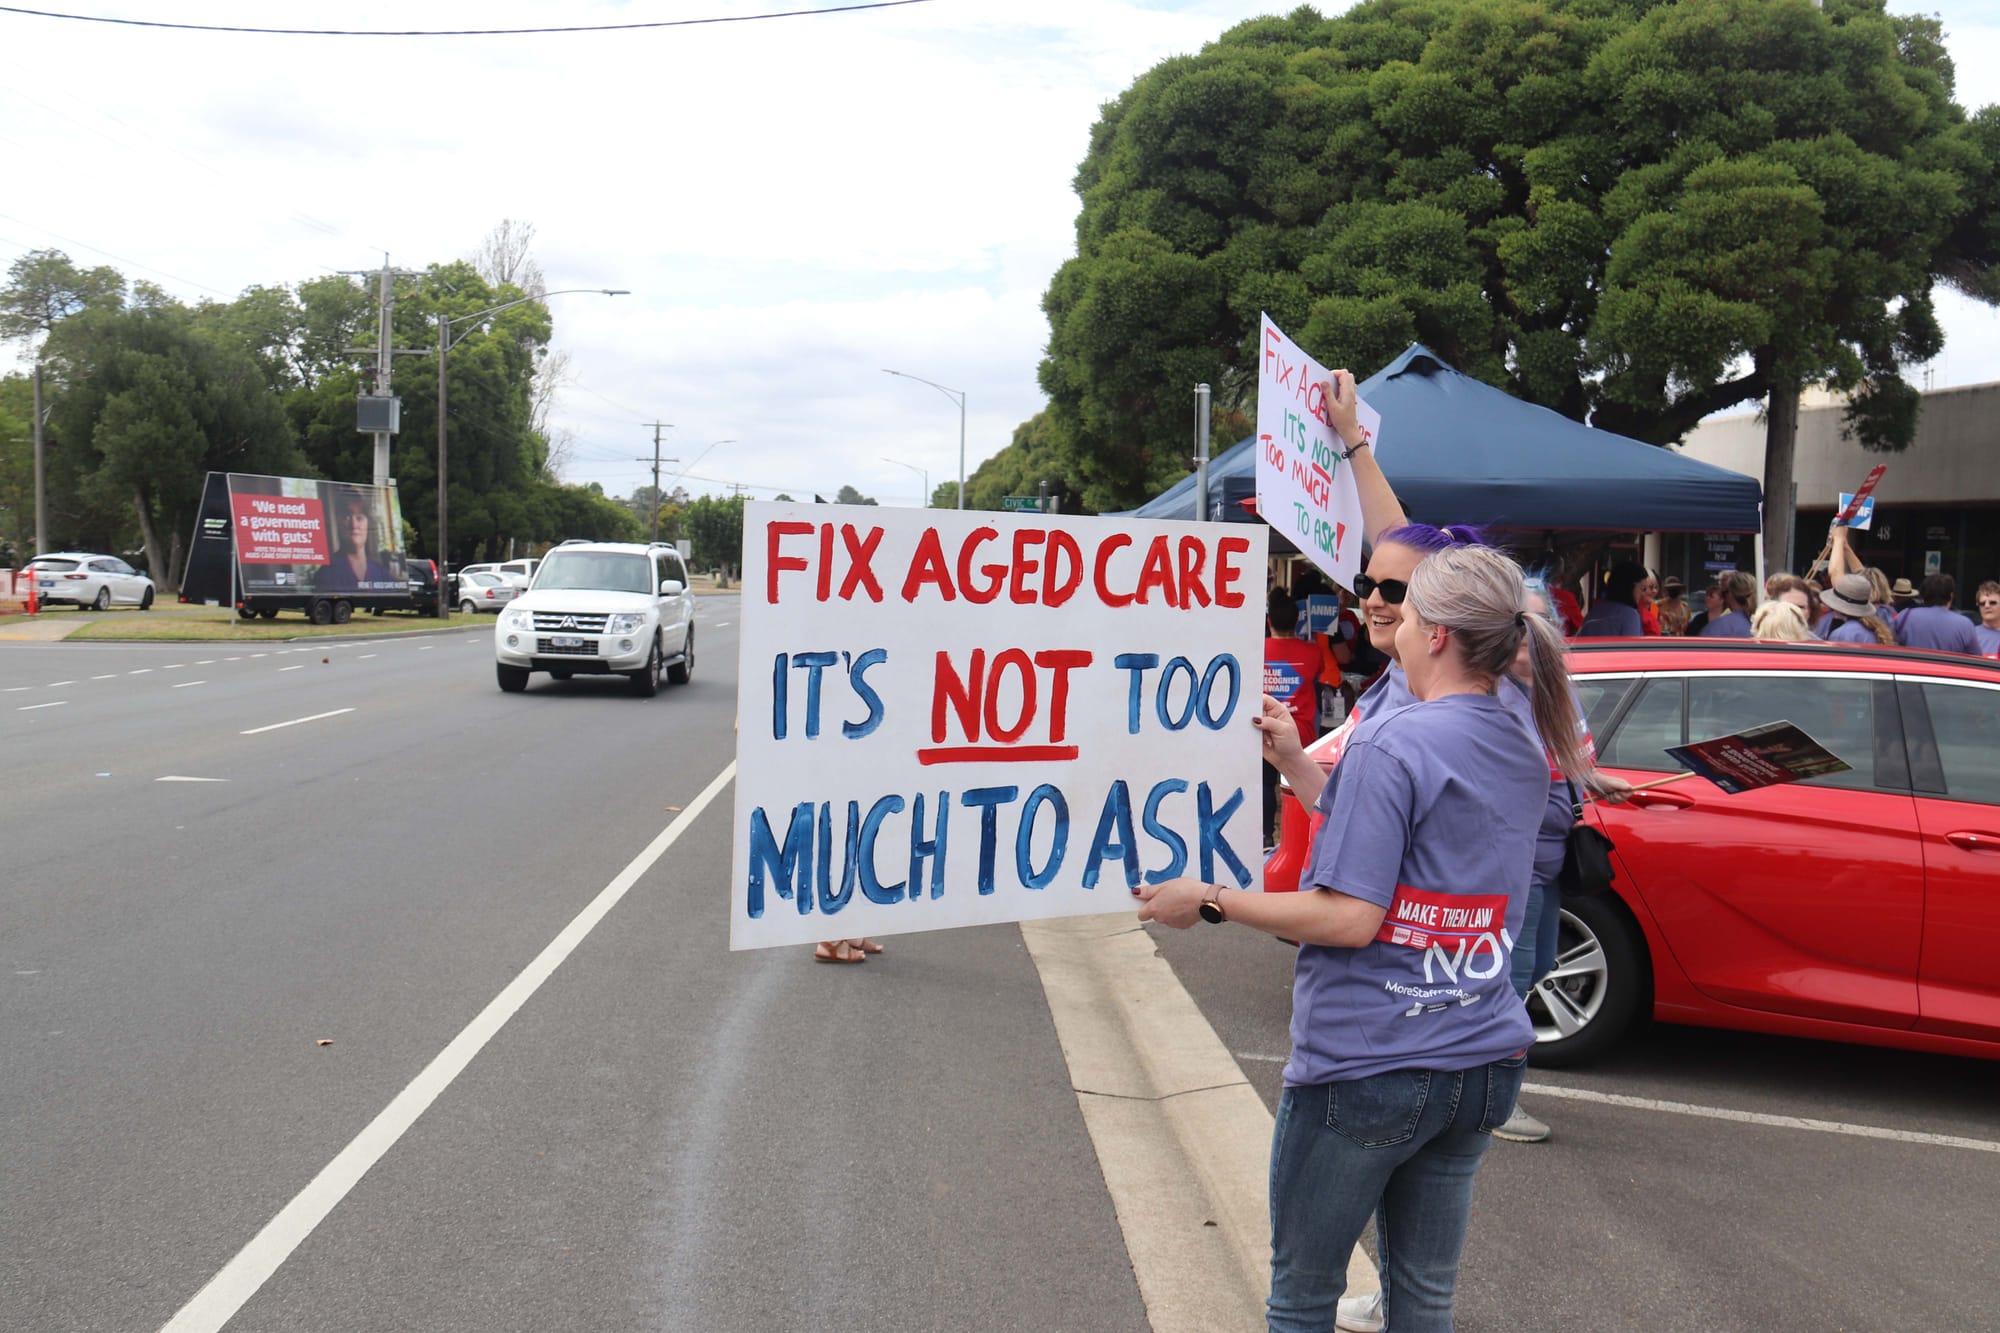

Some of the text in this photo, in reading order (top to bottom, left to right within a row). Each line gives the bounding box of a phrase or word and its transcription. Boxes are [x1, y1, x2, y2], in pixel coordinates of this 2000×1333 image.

[1266, 327, 1293, 390] FIX
[1283, 407, 1342, 481] IT'S NOT
[1261, 434, 1285, 472] TOO
[1292, 460, 1330, 512] MUCH
[240, 515, 249, 527] a
[250, 516, 321, 530] government
[277, 503, 306, 516] need
[252, 529, 281, 542] with
[1293, 501, 1310, 536] TO
[1314, 518, 1346, 562] ASK!
[1877, 525, 1892, 541] 48
[768, 521, 1249, 610] FIX AGED CARE
[1311, 604, 1338, 617] ANMF
[1264, 676, 1300, 685] ECOGNISE
[1264, 684, 1290, 693] EWARD
[774, 648, 887, 741] IT'S
[932, 648, 1093, 745] NOT
[1115, 652, 1240, 735] TOO
[748, 779, 1252, 918] MUCH TO ASK
[1397, 899, 1494, 928] MAKE THEM LAW
